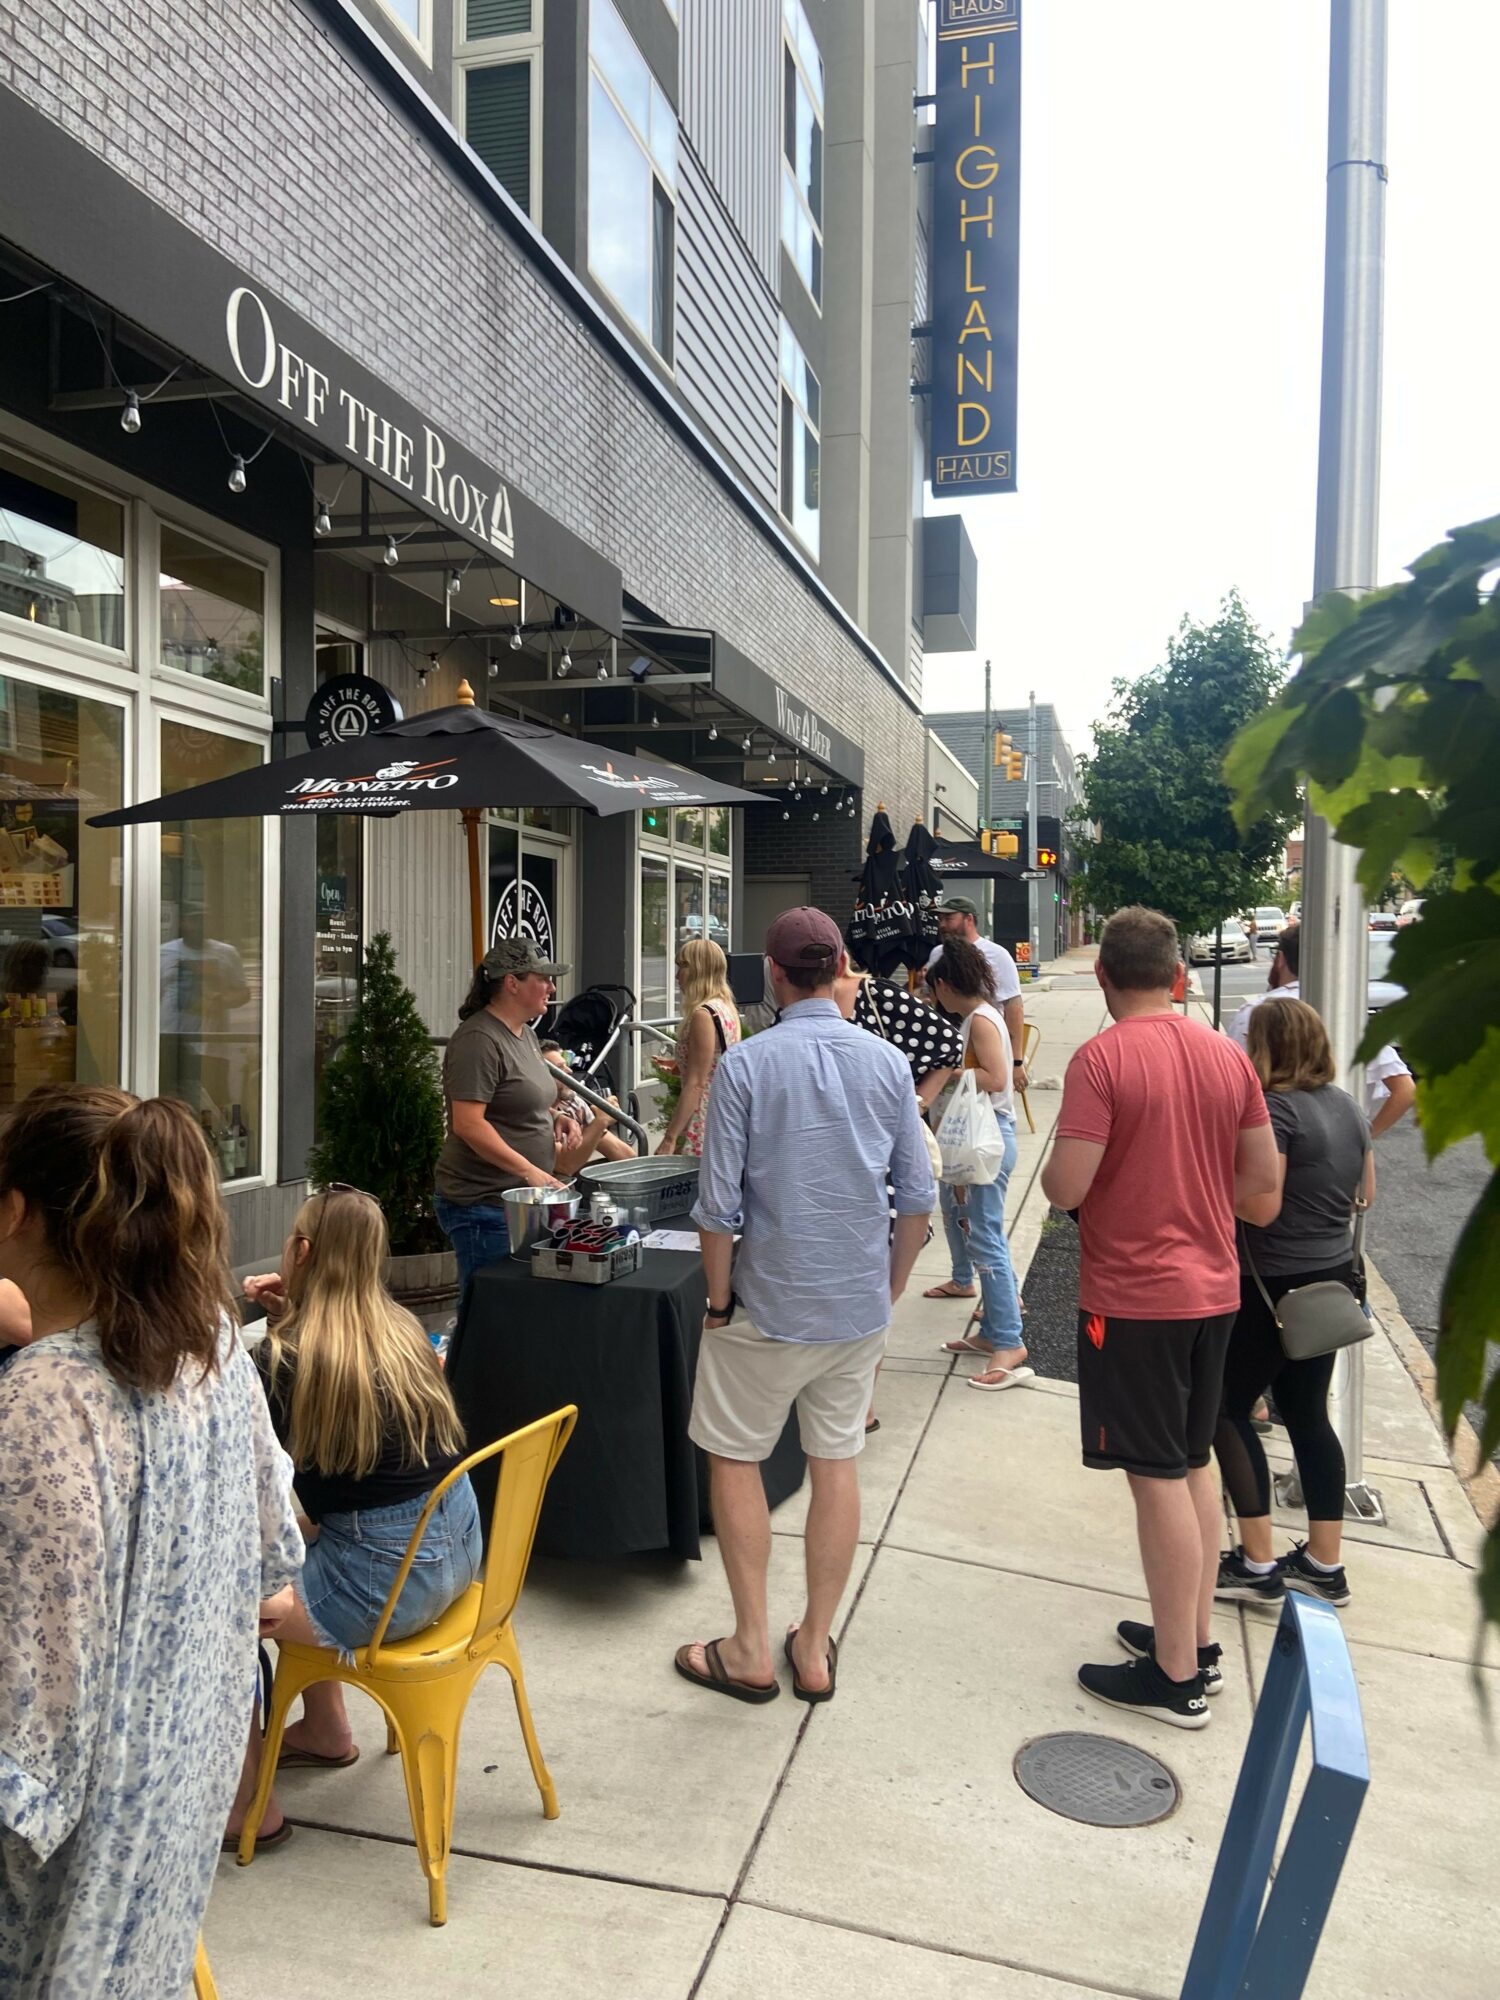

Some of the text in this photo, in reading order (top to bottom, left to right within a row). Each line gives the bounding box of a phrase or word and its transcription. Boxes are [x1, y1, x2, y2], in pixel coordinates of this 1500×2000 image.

[955, 42, 999, 446] HIGHLAND
[226, 287, 330, 427] OFF
[340, 389, 414, 491] THE
[940, 455, 1008, 481] HAUS
[319, 695, 336, 717] OFF
[338, 688, 360, 701] THE
[285, 774, 459, 793] MIONETTO
[321, 882, 340, 906] Open
[497, 897, 513, 940] OFF
[533, 902, 549, 945] ROX
[316, 932, 336, 940] Monday
[341, 933, 359, 942] Sunday
